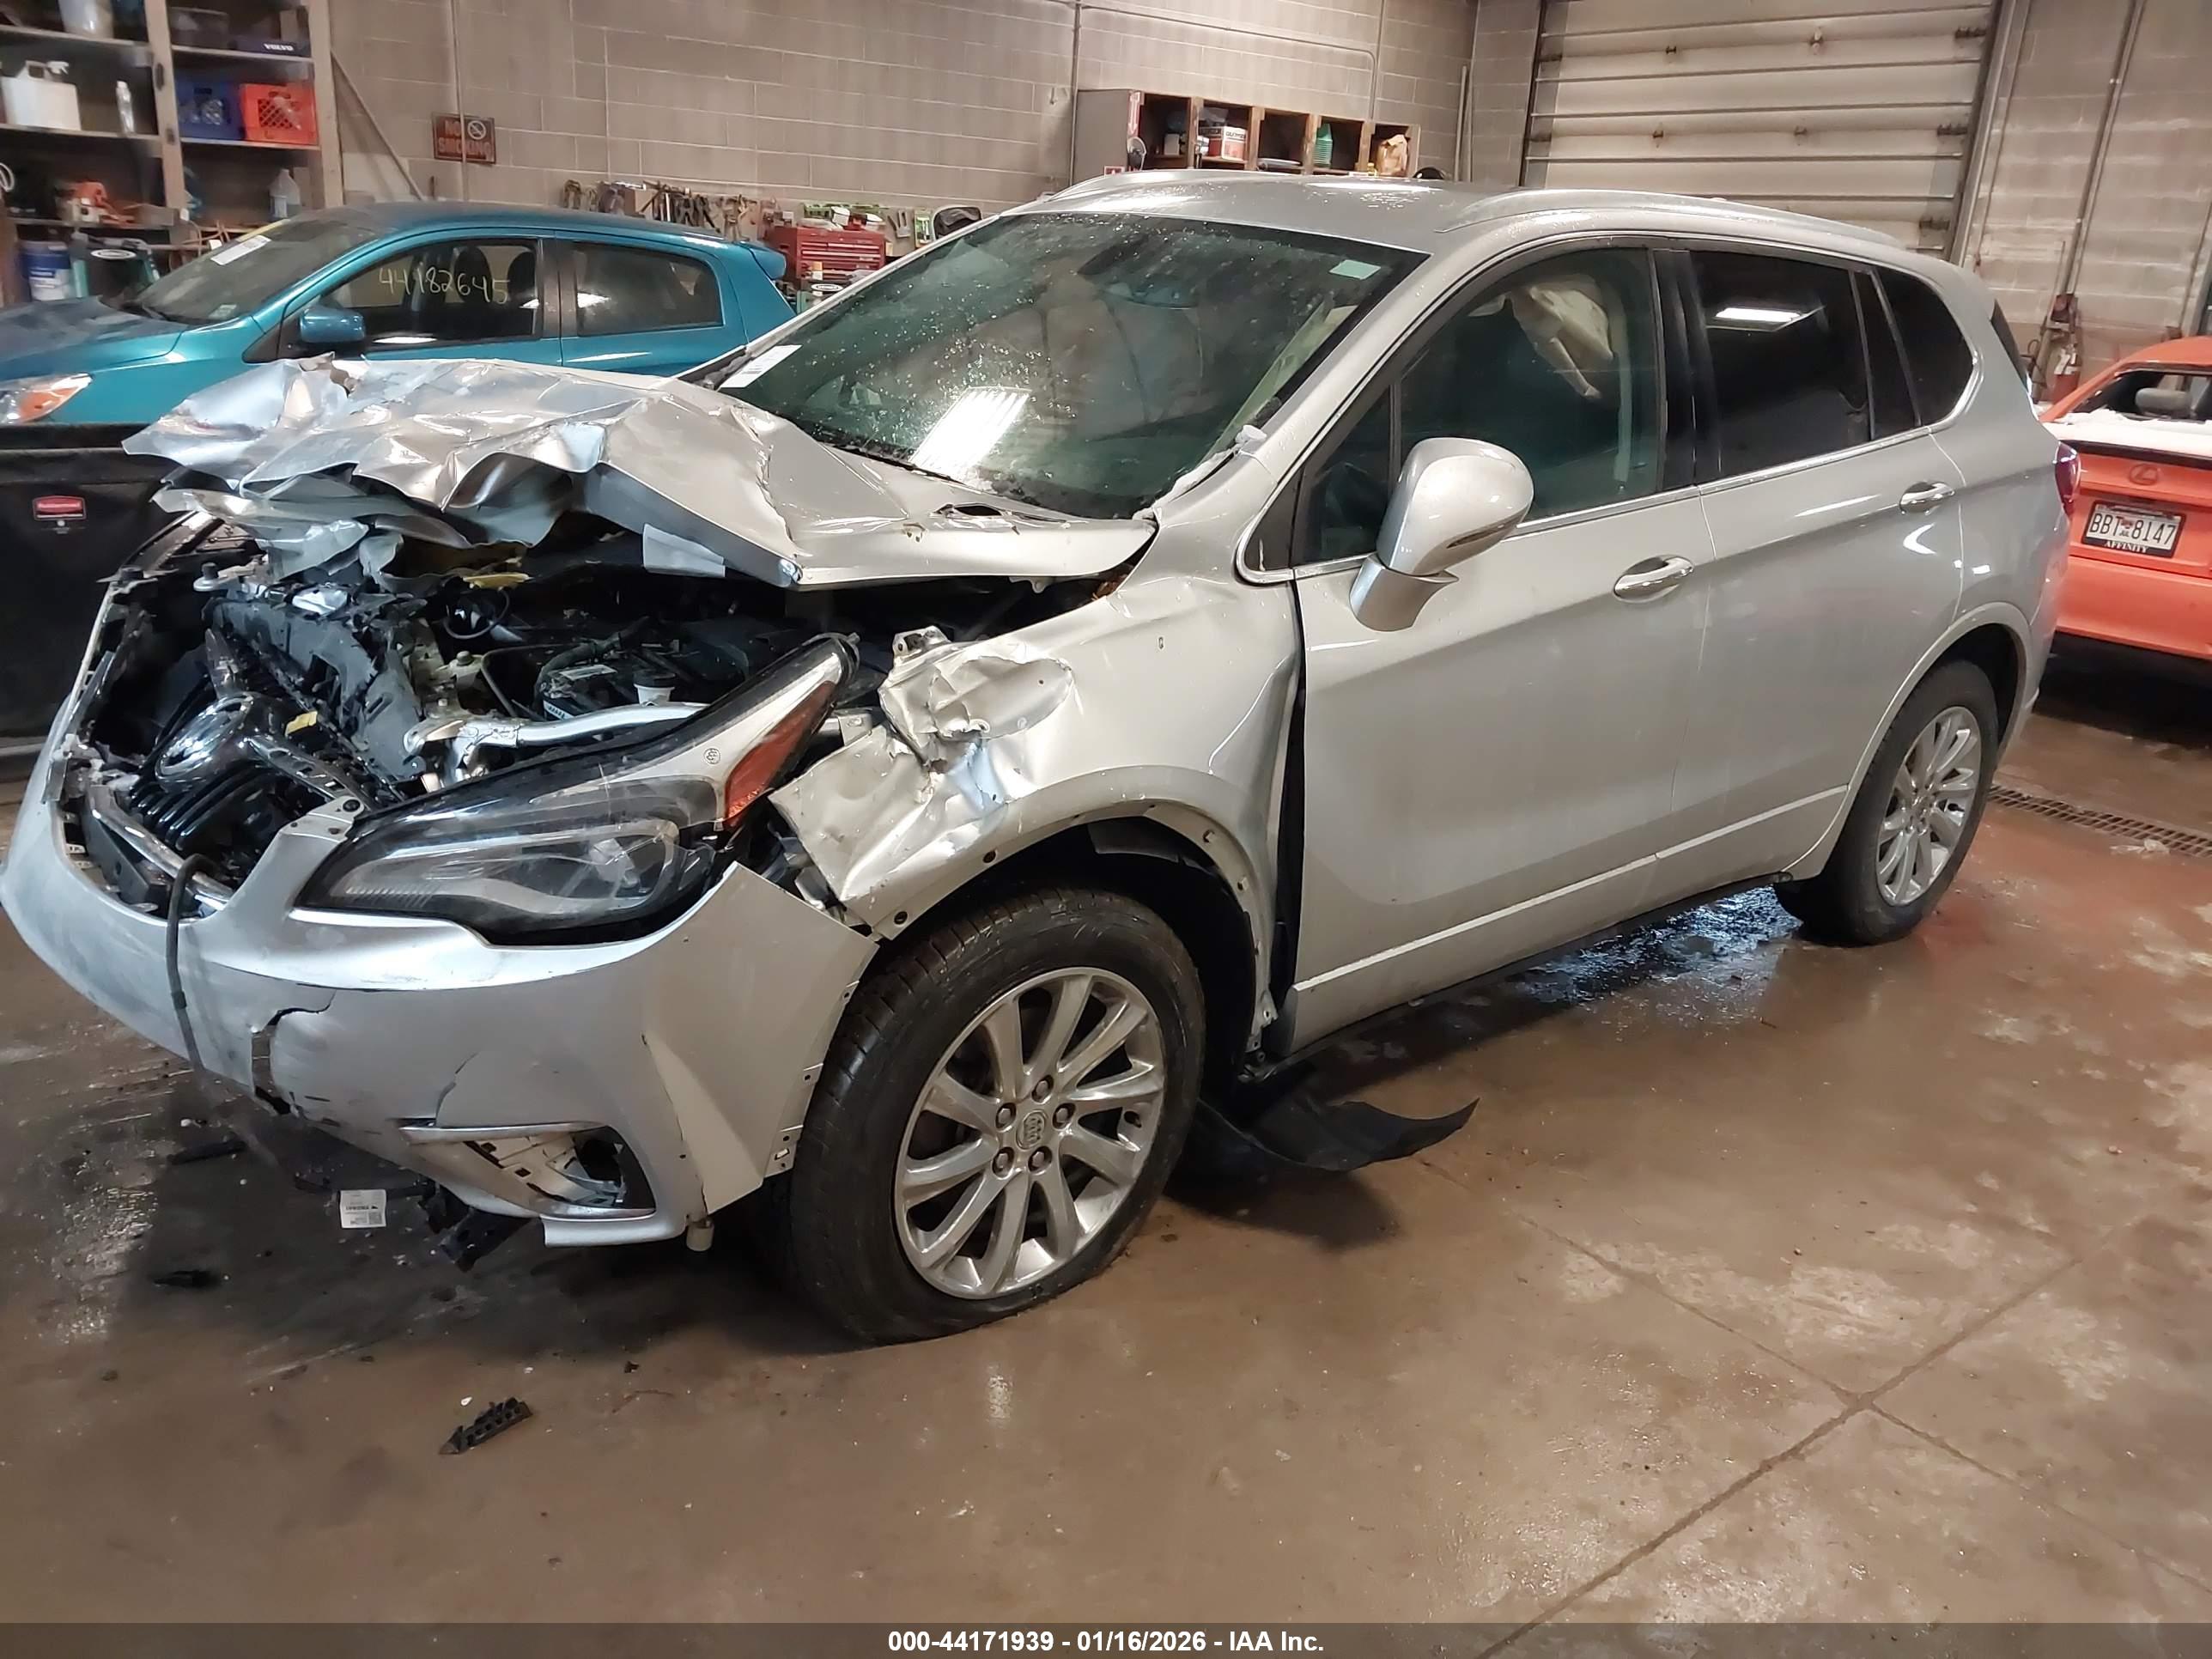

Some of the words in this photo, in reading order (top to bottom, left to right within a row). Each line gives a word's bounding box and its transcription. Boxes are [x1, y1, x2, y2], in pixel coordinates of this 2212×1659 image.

[444, 119, 462, 137] NO
[379, 266, 510, 305] 44182645
[2104, 540, 2148, 554] AFFINITY
